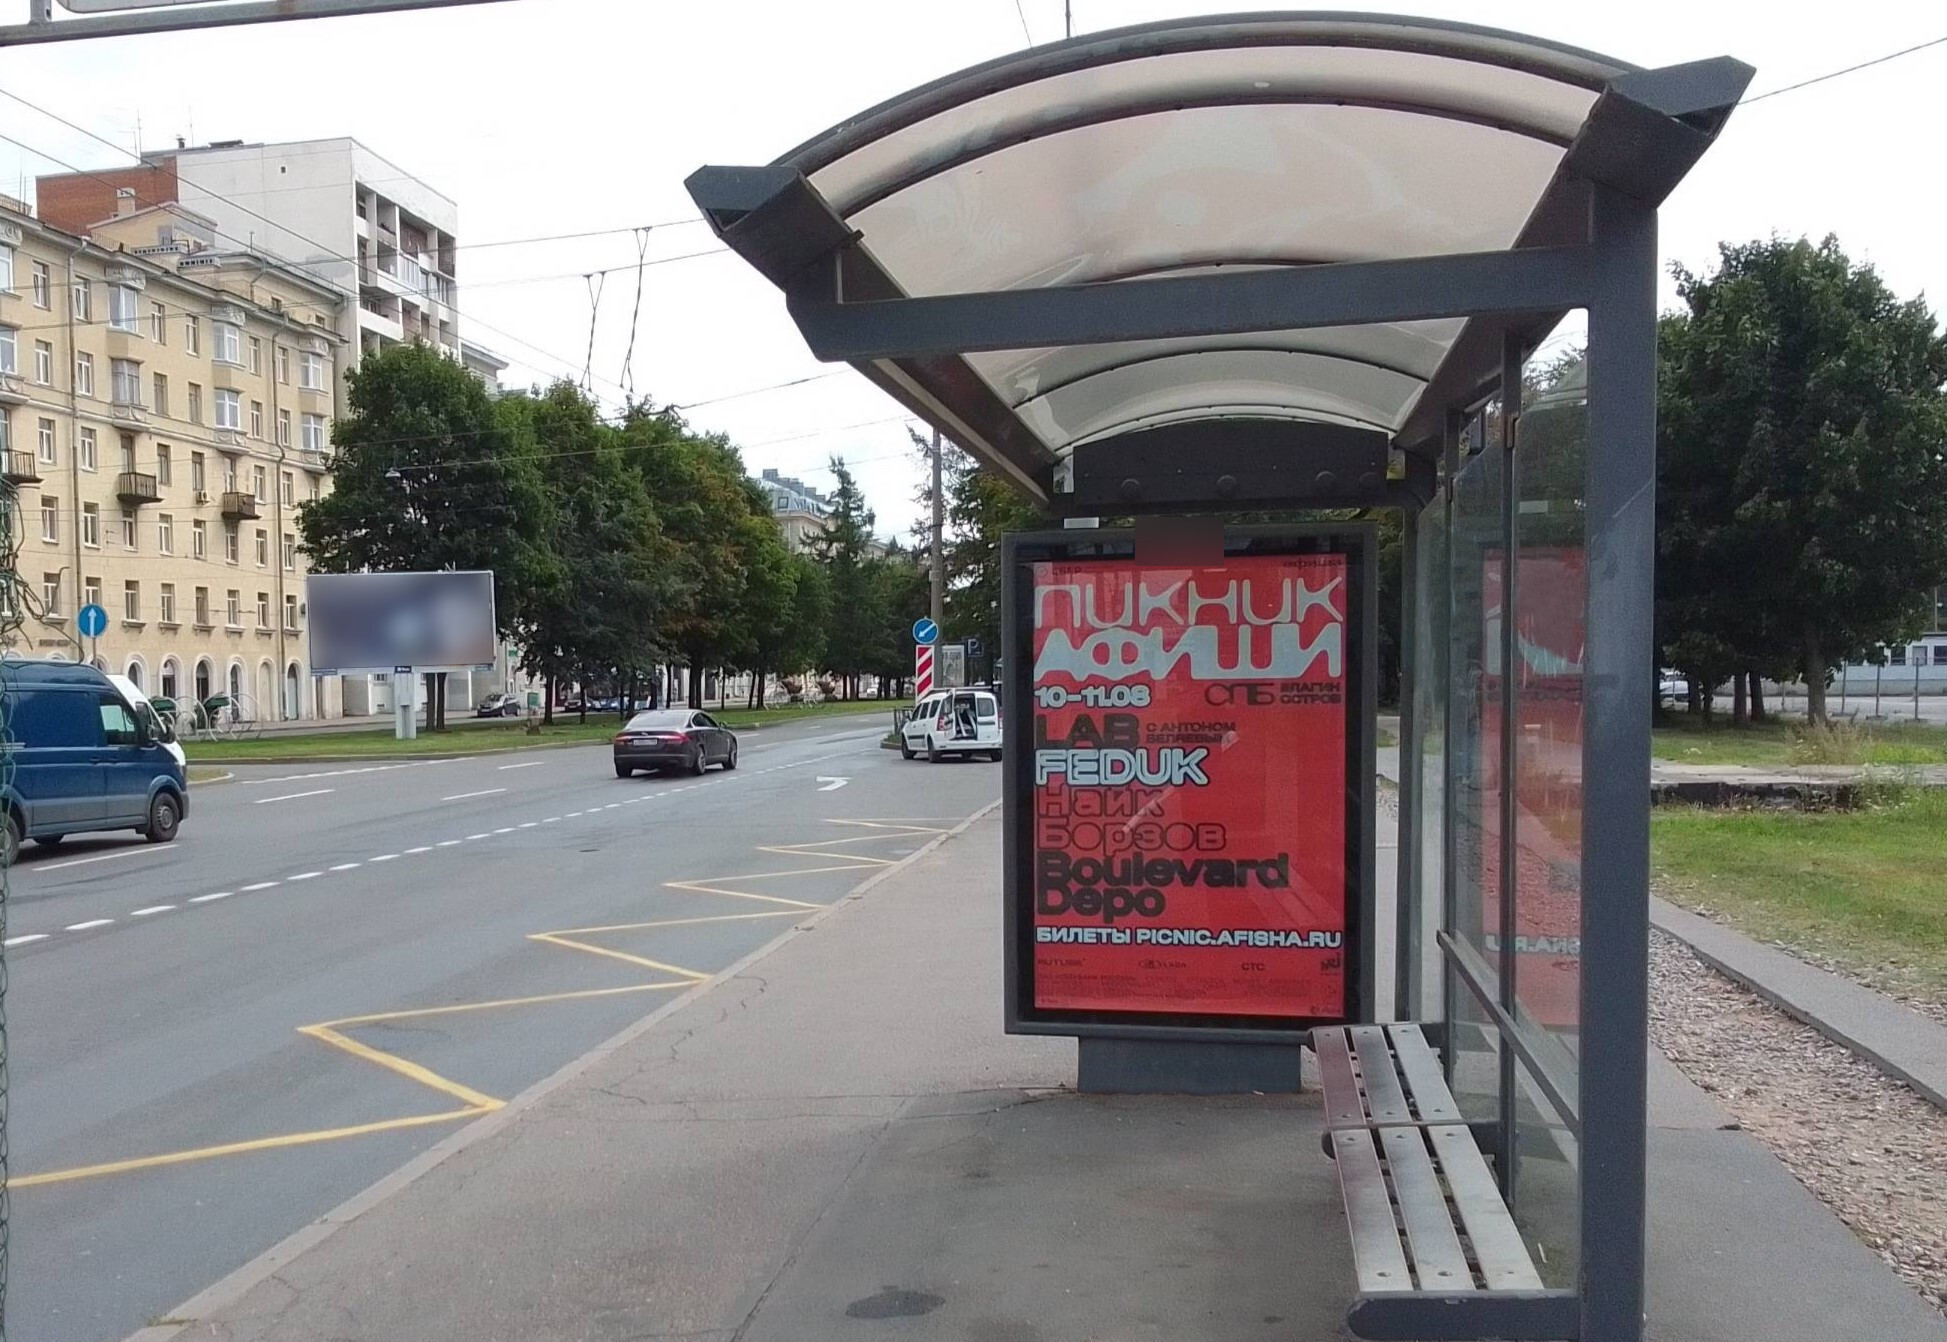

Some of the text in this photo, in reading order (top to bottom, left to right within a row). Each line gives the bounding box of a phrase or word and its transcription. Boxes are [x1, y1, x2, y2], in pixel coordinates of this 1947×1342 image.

[1034, 577, 1343, 629] ПИКНИК
[1033, 622, 1341, 682] АФИШИ
[1204, 682, 1275, 707] СПБ
[1036, 714, 1140, 750] LAB
[1161, 721, 1236, 732] АНТОНОМ
[1034, 748, 1209, 786] FEDUK
[1037, 817, 1227, 857] Борзов
[1037, 852, 1289, 888] Boulevard
[1036, 887, 1166, 924] Depo
[1035, 926, 1342, 948] БИЛЕТЫ PICNIC.AFISHA.RU
